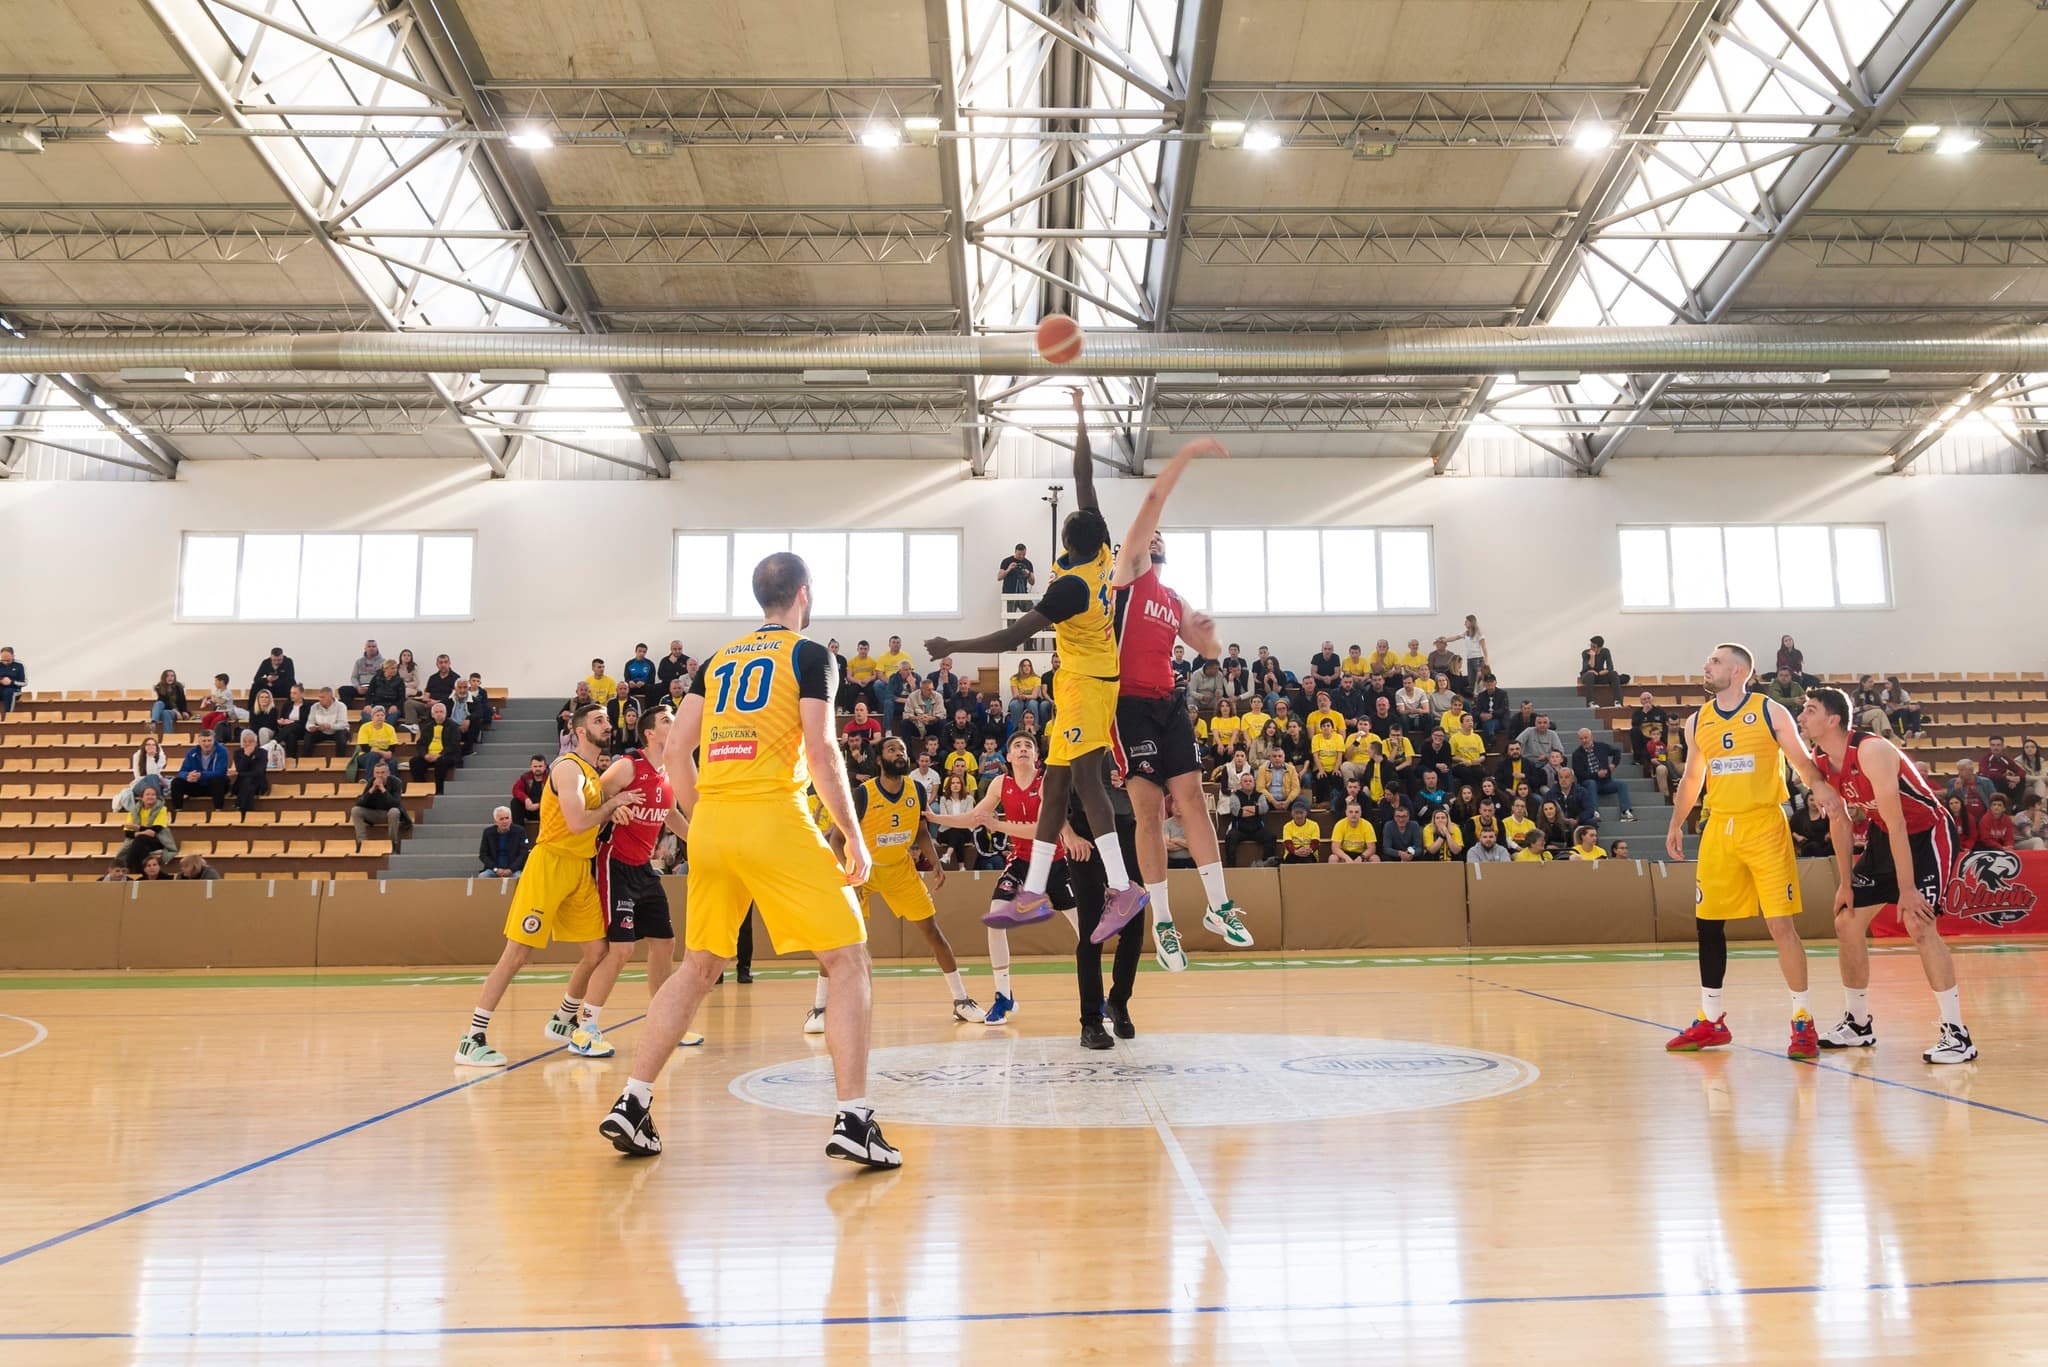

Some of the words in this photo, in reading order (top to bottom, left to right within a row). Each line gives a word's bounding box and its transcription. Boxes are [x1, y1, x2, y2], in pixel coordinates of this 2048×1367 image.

[713, 657, 775, 714] 10
[1063, 727, 1082, 744] 12
[1722, 732, 1734, 750] 6
[655, 787, 662, 803] 3
[891, 814, 900, 828] 3
[1066, 883, 1075, 898] 1
[1193, 953, 1594, 967] DVORANA
